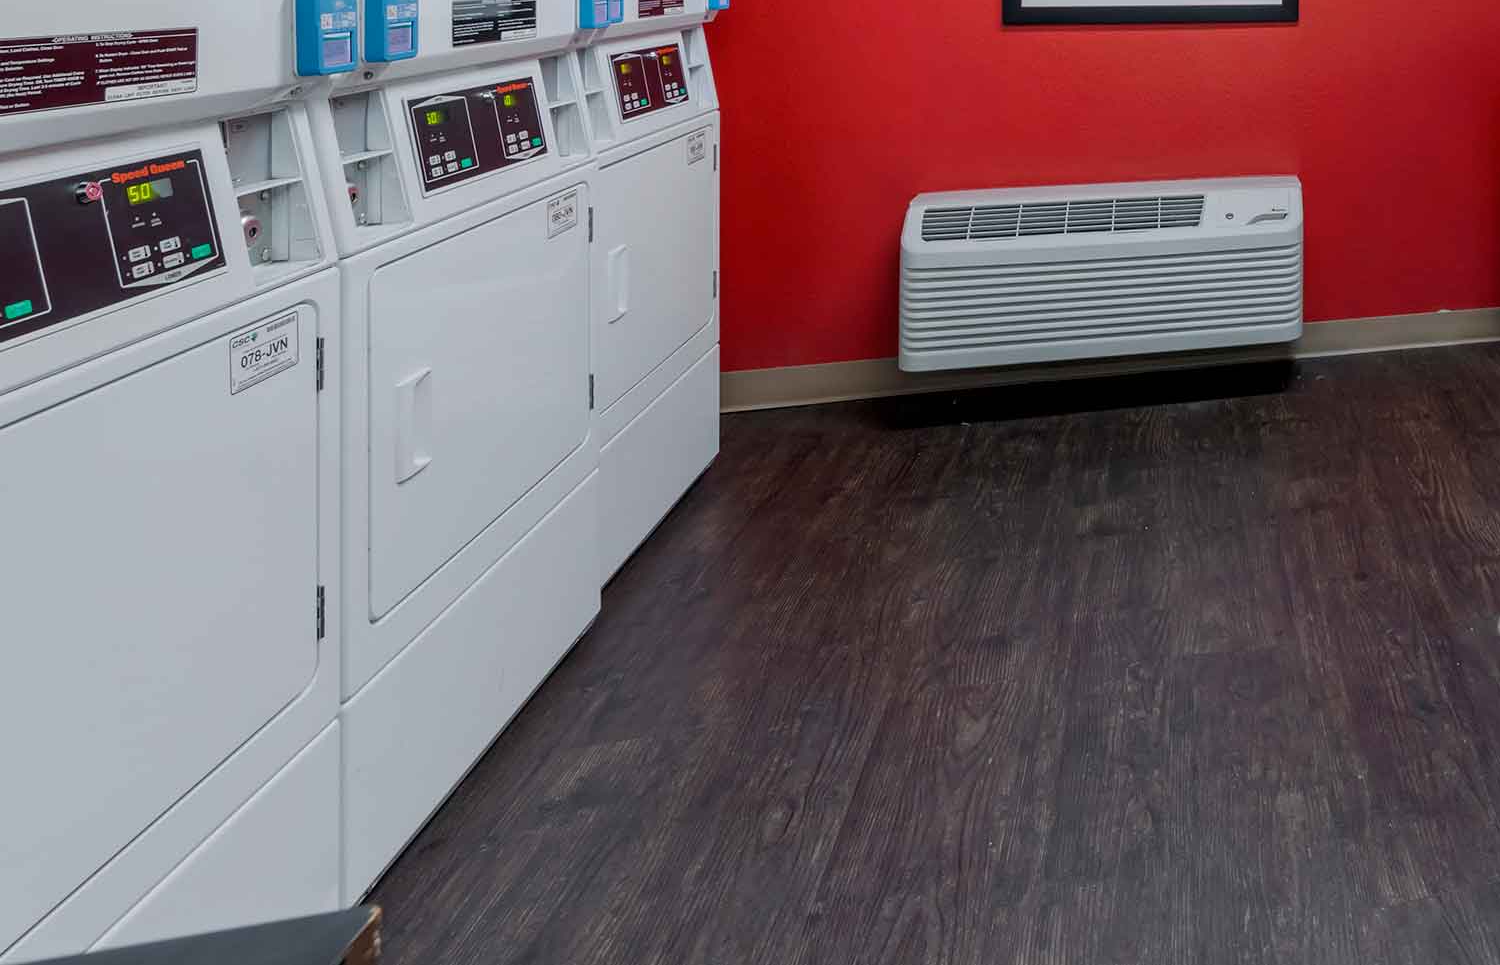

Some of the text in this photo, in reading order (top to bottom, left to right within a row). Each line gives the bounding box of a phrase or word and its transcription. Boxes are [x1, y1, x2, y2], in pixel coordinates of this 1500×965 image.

[111, 160, 185, 184] Speed Queen
[129, 183, 150, 204] 50
[232, 336, 250, 348] CSC
[241, 337, 288, 368] 078-JVN
